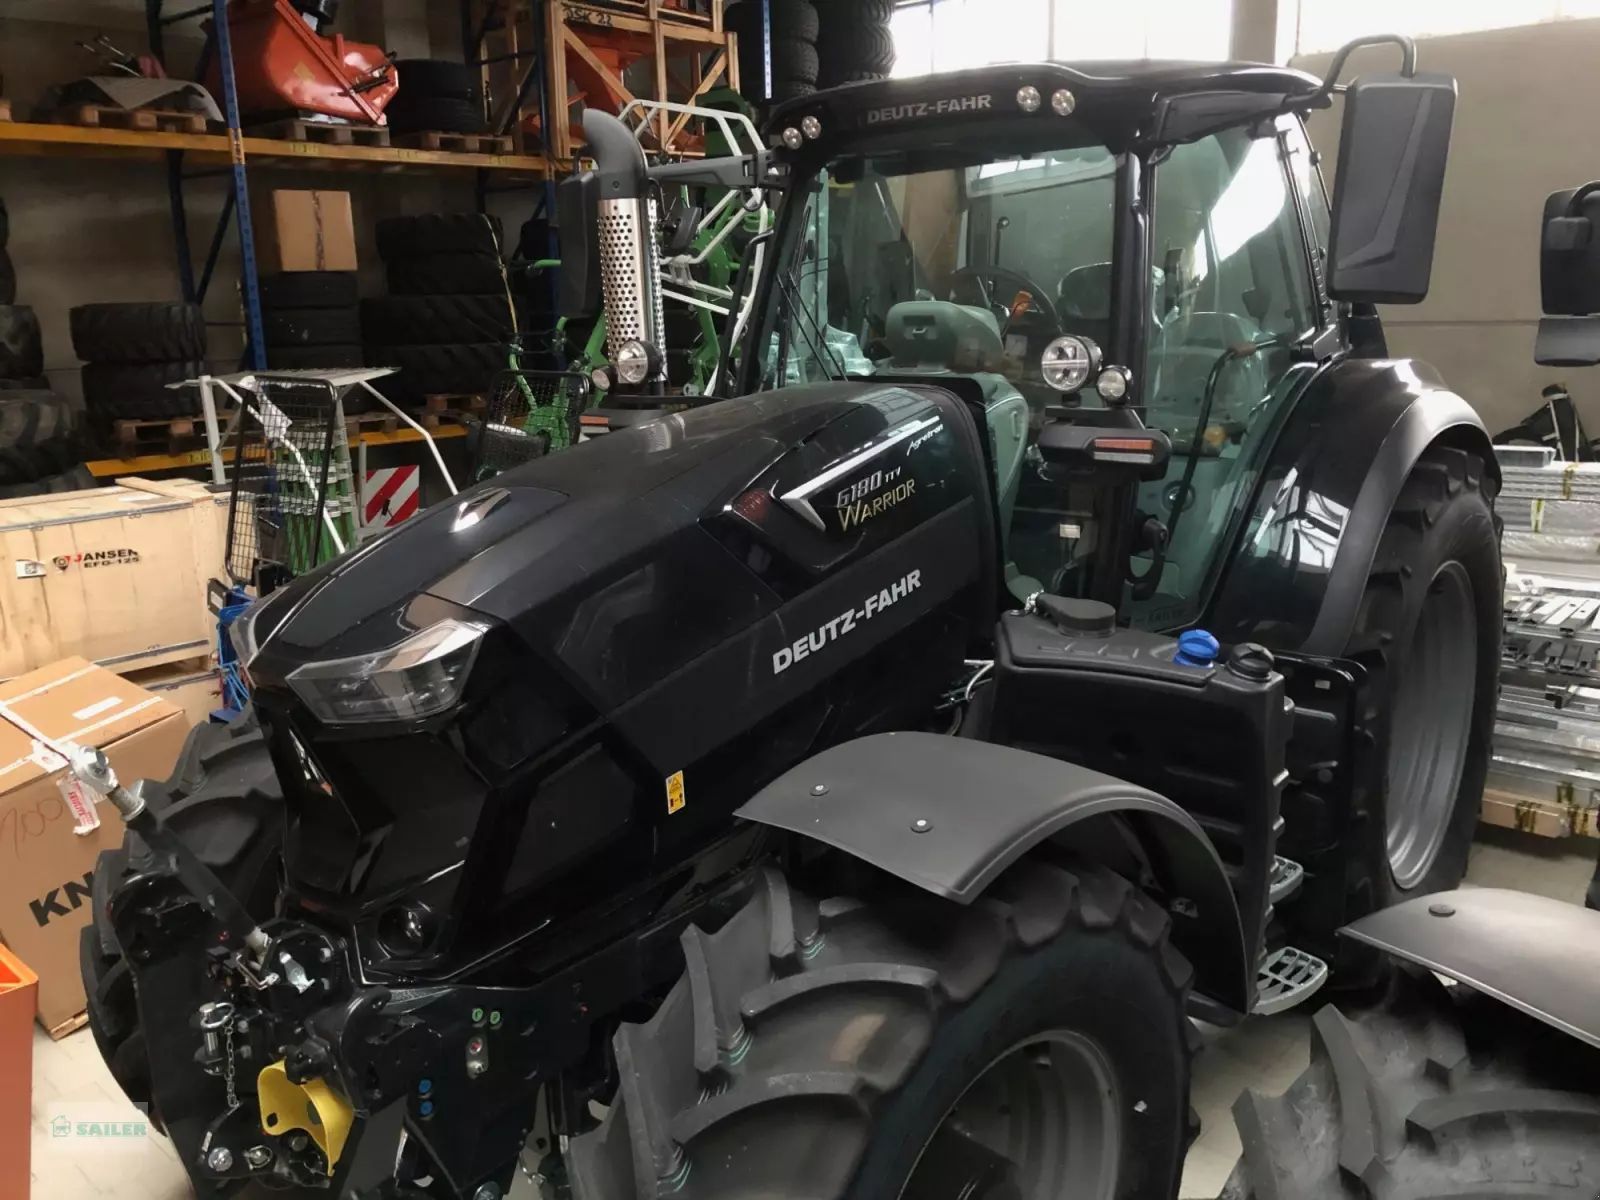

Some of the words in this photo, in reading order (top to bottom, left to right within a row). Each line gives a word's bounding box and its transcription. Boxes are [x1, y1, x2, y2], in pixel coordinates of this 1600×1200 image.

[867, 94, 992, 124] DEUTZ-FAHR
[837, 470, 882, 508] 6180
[885, 466, 901, 482] TTV
[838, 478, 915, 532] WARRIOR
[74, 548, 139, 563] JANSEN
[772, 568, 922, 675] DEUTZ-FAHR
